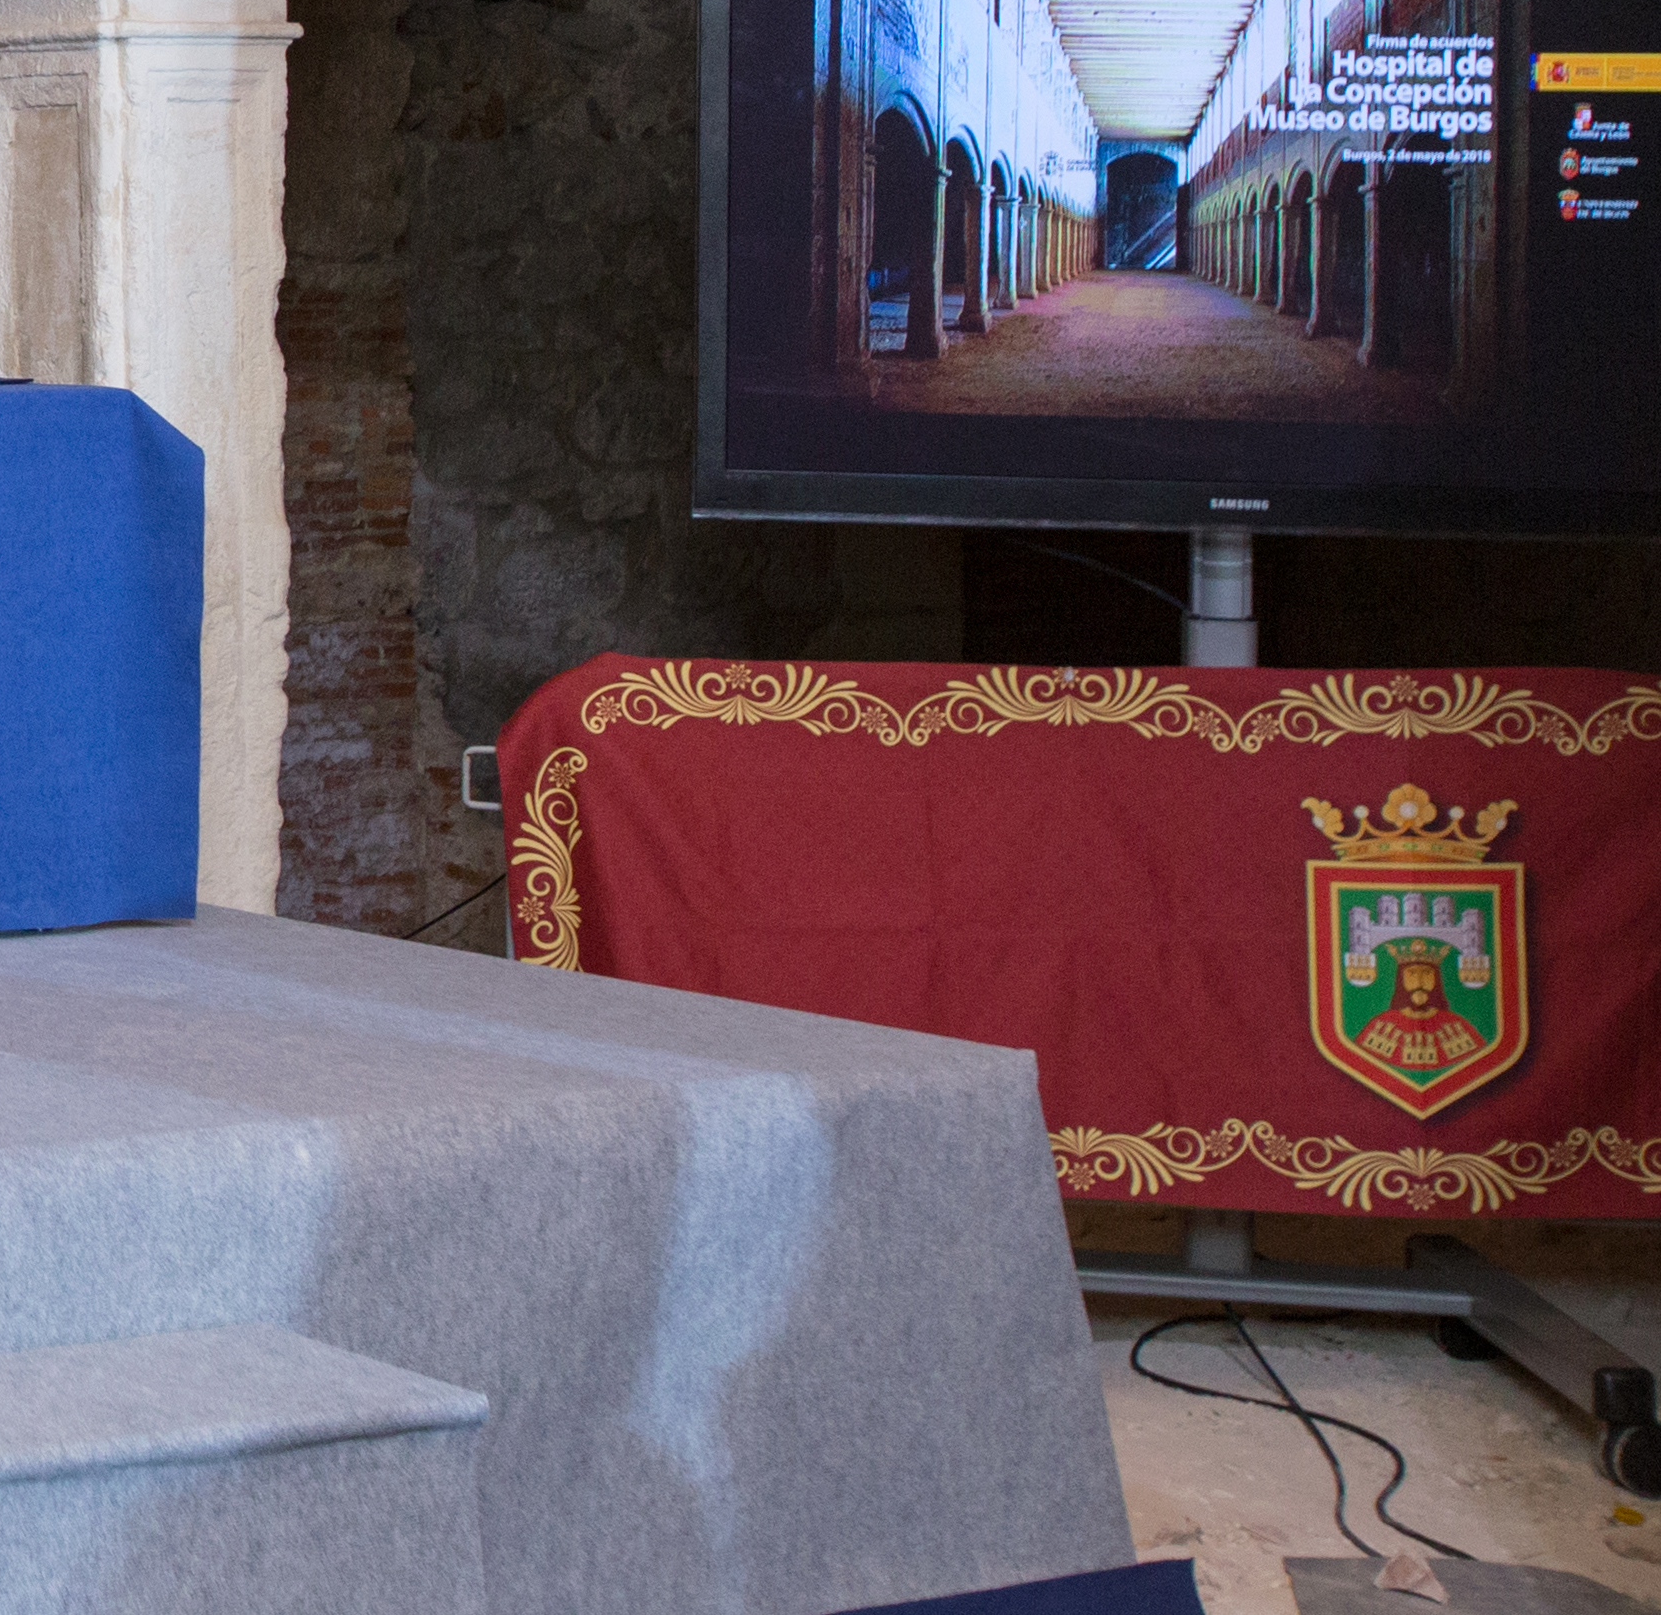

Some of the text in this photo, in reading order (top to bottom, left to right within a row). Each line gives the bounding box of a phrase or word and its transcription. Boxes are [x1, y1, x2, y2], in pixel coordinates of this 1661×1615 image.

[1367, 33, 1494, 50] Firma de acuerdos
[1332, 49, 1494, 82] Hospital de
[1327, 77, 1493, 110] Concepción
[1248, 104, 1493, 140] Museo de Burgos
[1342, 148, 1386, 164] Burgos,
[1387, 149, 1396, 161] 2
[1396, 148, 1411, 162] de
[1412, 152, 1445, 165] mayo
[1445, 149, 1461, 162] de
[1210, 498, 1270, 511] SAMSUNG
